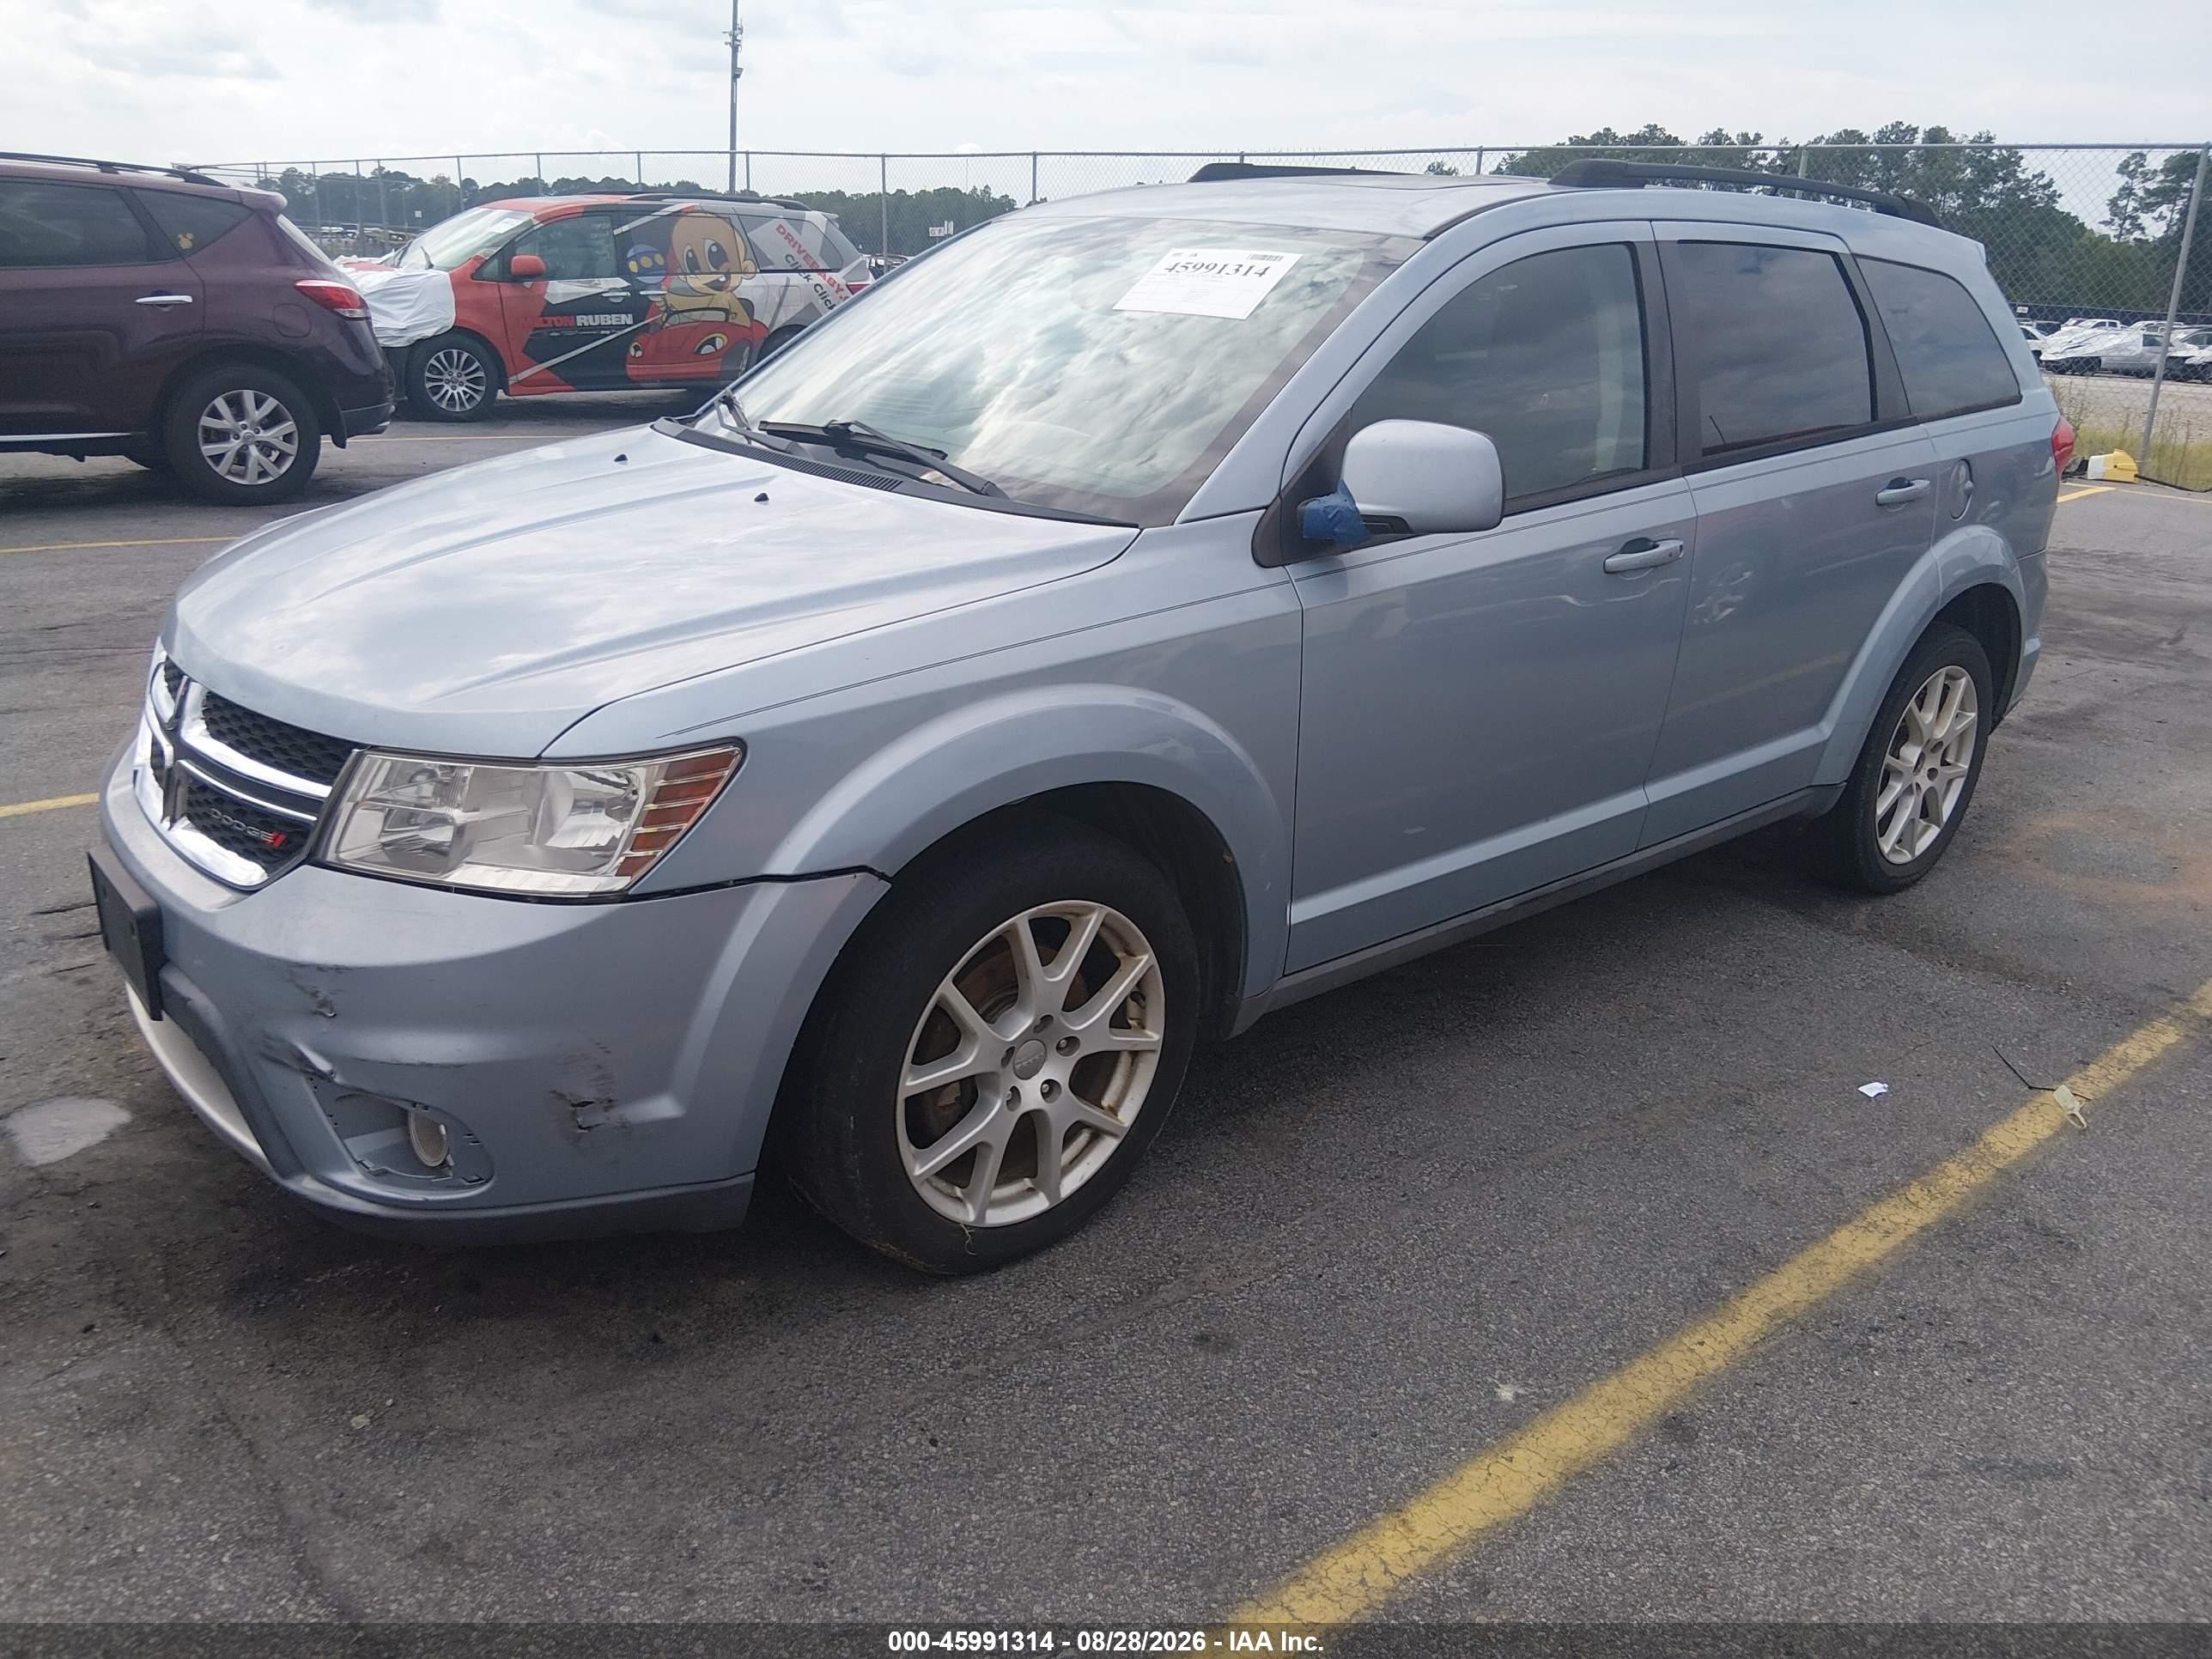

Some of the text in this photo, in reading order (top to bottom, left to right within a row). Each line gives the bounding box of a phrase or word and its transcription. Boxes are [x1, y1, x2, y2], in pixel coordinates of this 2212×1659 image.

[1164, 262, 1271, 277] 45991314
[576, 313, 634, 326] RUBEN
[210, 808, 275, 843] DODGE
